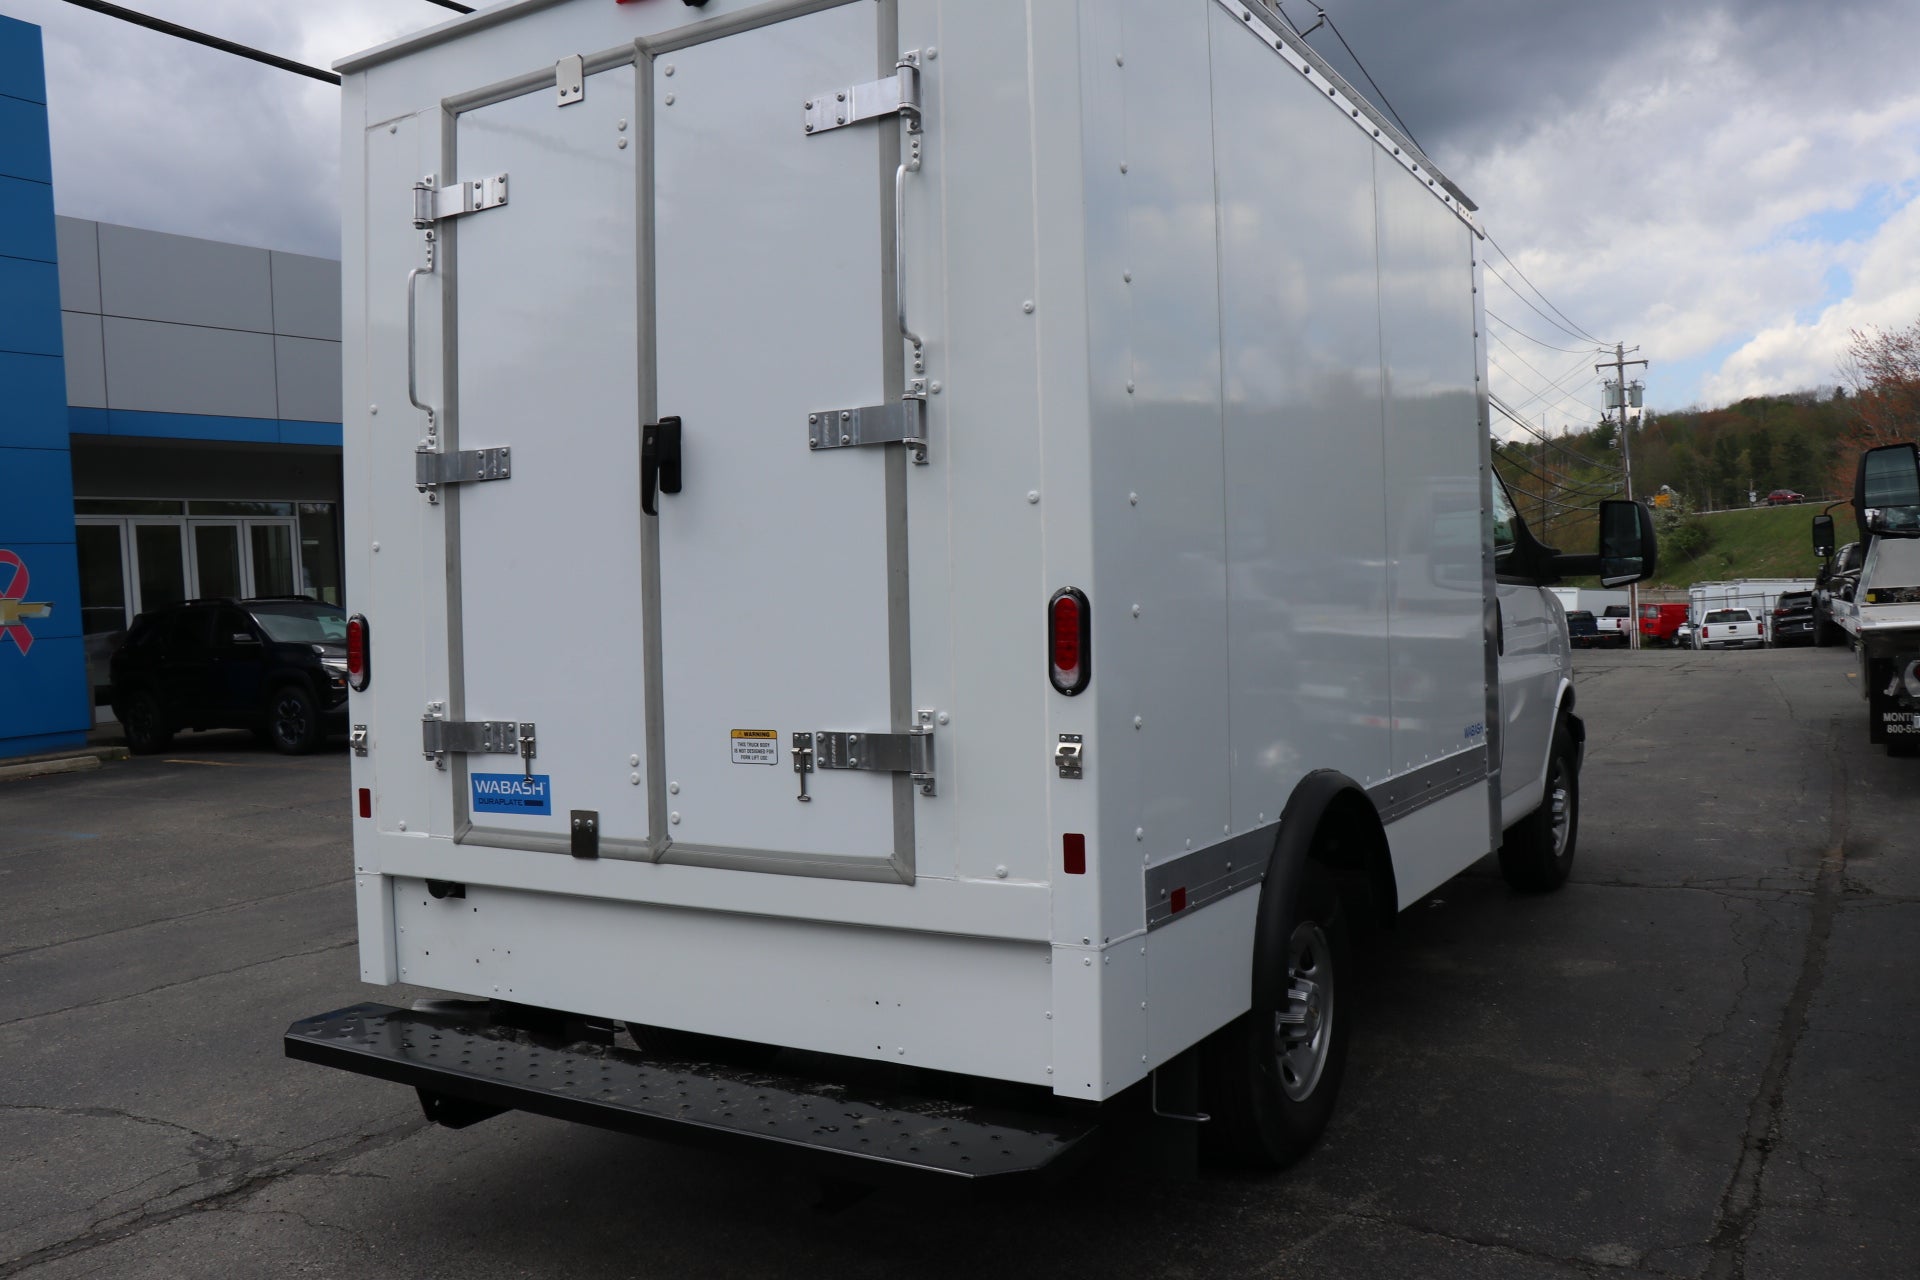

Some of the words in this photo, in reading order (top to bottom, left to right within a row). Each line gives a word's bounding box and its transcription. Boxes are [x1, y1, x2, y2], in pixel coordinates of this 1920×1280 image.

[1883, 712, 1920, 722] MONTI
[474, 780, 544, 796] WABASH
[478, 797, 523, 806] DURAPLATE
